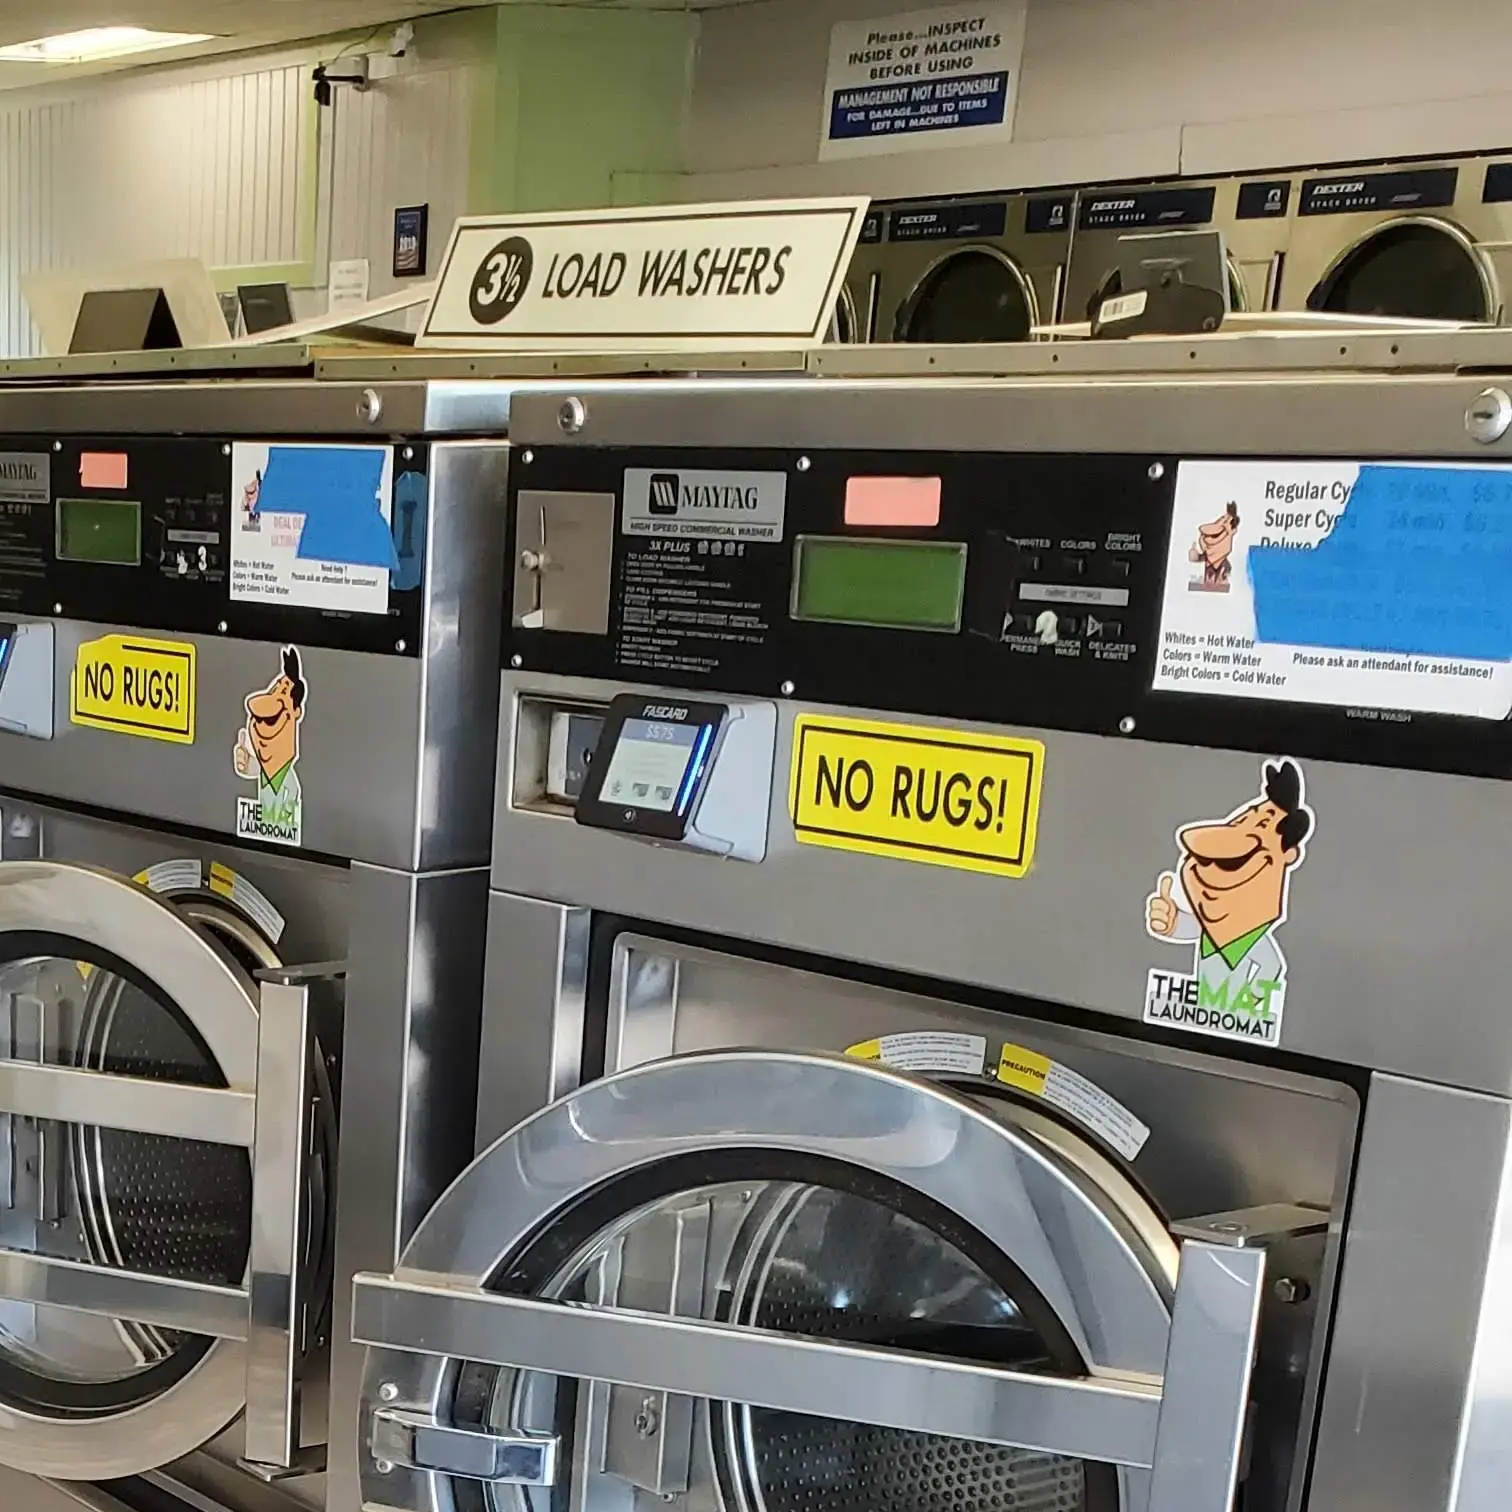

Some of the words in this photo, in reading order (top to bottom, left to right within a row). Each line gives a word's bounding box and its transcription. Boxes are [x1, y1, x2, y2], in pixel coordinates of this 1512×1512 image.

[848, 48, 892, 66] INSIDE
[899, 45, 918, 59] OF
[924, 33, 1001, 56] MACHINES
[870, 62, 921, 80] BEFORE
[928, 56, 973, 73] USING
[838, 89, 908, 109] MANAGEMENT
[911, 85, 933, 101] NOT
[935, 77, 1000, 99] RESPONSIBLE
[847, 111, 865, 122] FOR
[942, 102, 955, 113] TO
[958, 99, 988, 111] ITEMS
[872, 120, 890, 131] LEFT
[894, 118, 906, 128] IN
[909, 114, 959, 127] MACHINES
[1311, 182, 1365, 195] DEXTER
[1090, 200, 1136, 211] DEXTER
[899, 214, 937, 224] DEXTER
[541, 252, 626, 299] LOAD
[636, 245, 792, 297] WASHERS
[682, 485, 758, 510] MAYTAG
[1265, 481, 1327, 504] Regular
[1264, 508, 1311, 531] Super
[630, 523, 650, 531] HIGH
[652, 523, 678, 532] SPEED
[680, 525, 735, 535] COMMERCIAL
[738, 528, 774, 537] WASHER
[663, 541, 691, 552] PLUS
[1060, 540, 1096, 550] COLORS
[1011, 644, 1038, 653] PRESS
[1089, 641, 1137, 653] DELICATES
[1165, 632, 1196, 645] Whites
[1207, 634, 1224, 647] Hot
[1226, 636, 1255, 649] Water
[1163, 648, 1191, 661] Colors
[1203, 651, 1230, 664] Warm
[1233, 653, 1261, 667] Water
[1292, 652, 1324, 667] Please
[1327, 655, 1344, 668] ask
[1347, 658, 1359, 669] an
[1361, 659, 1412, 673] attendant
[1414, 661, 1429, 673] for
[1431, 663, 1494, 680] assistance!
[1161, 665, 1188, 680] Bright
[1192, 667, 1221, 680] Colors
[1232, 670, 1254, 684] Cold
[1256, 673, 1287, 686] Water
[84, 661, 114, 701] NO
[123, 666, 179, 713] RUGS!
[642, 705, 688, 720] FASCARD
[1346, 709, 1379, 720] WARM
[1380, 711, 1412, 723] WASH
[815, 755, 874, 811] NO
[891, 765, 1007, 834] RUGS!
[240, 802, 262, 821] THE
[240, 820, 297, 840] LAUNDROMAT
[1153, 974, 1199, 1005] THE
[1199, 973, 1282, 1019] MAT
[1149, 1000, 1275, 1038] LAUNDROMAT
[1002, 1059, 1046, 1081] PRECAUTION
